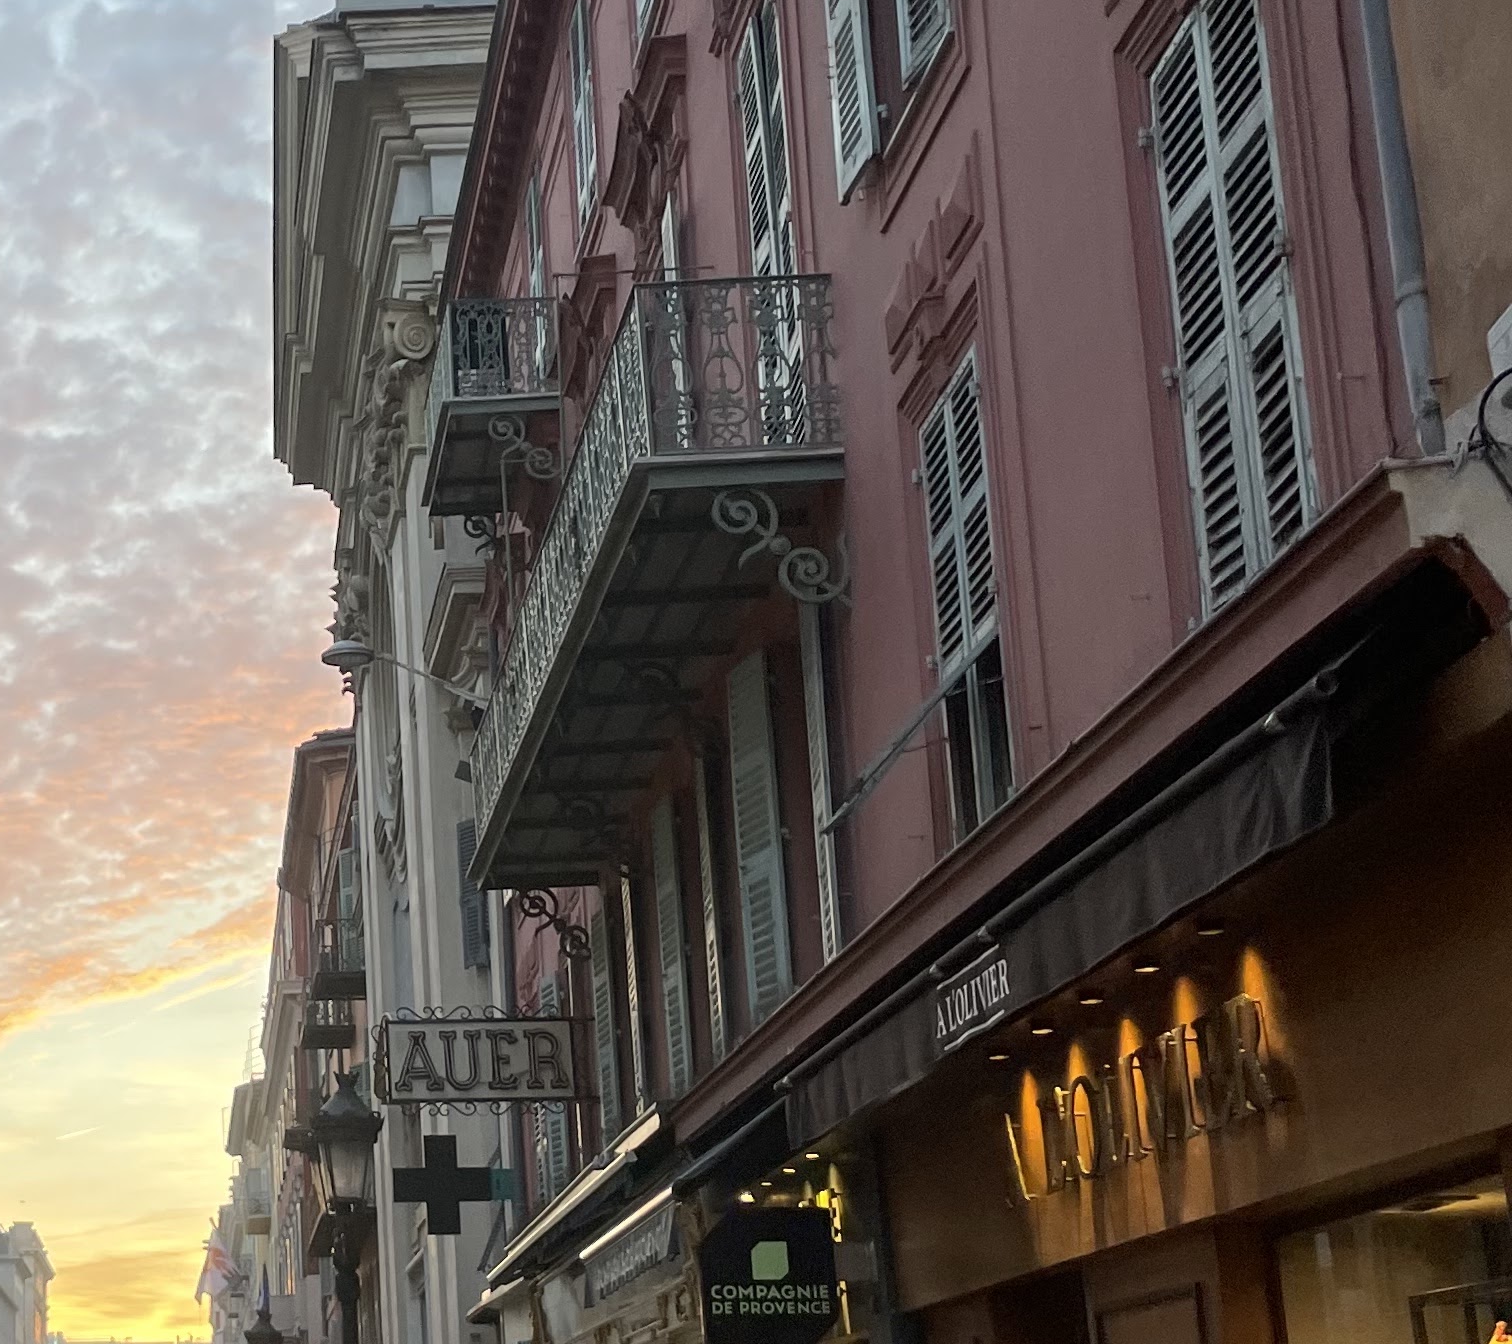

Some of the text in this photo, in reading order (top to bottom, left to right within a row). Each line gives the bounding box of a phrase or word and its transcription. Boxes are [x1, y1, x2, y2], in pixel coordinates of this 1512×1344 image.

[936, 958, 1011, 1039] A L'OLIVIER
[394, 1027, 571, 1093] AUER
[710, 1284, 829, 1300] COMPAGNIE
[711, 1301, 831, 1315] DE PROVENCE
